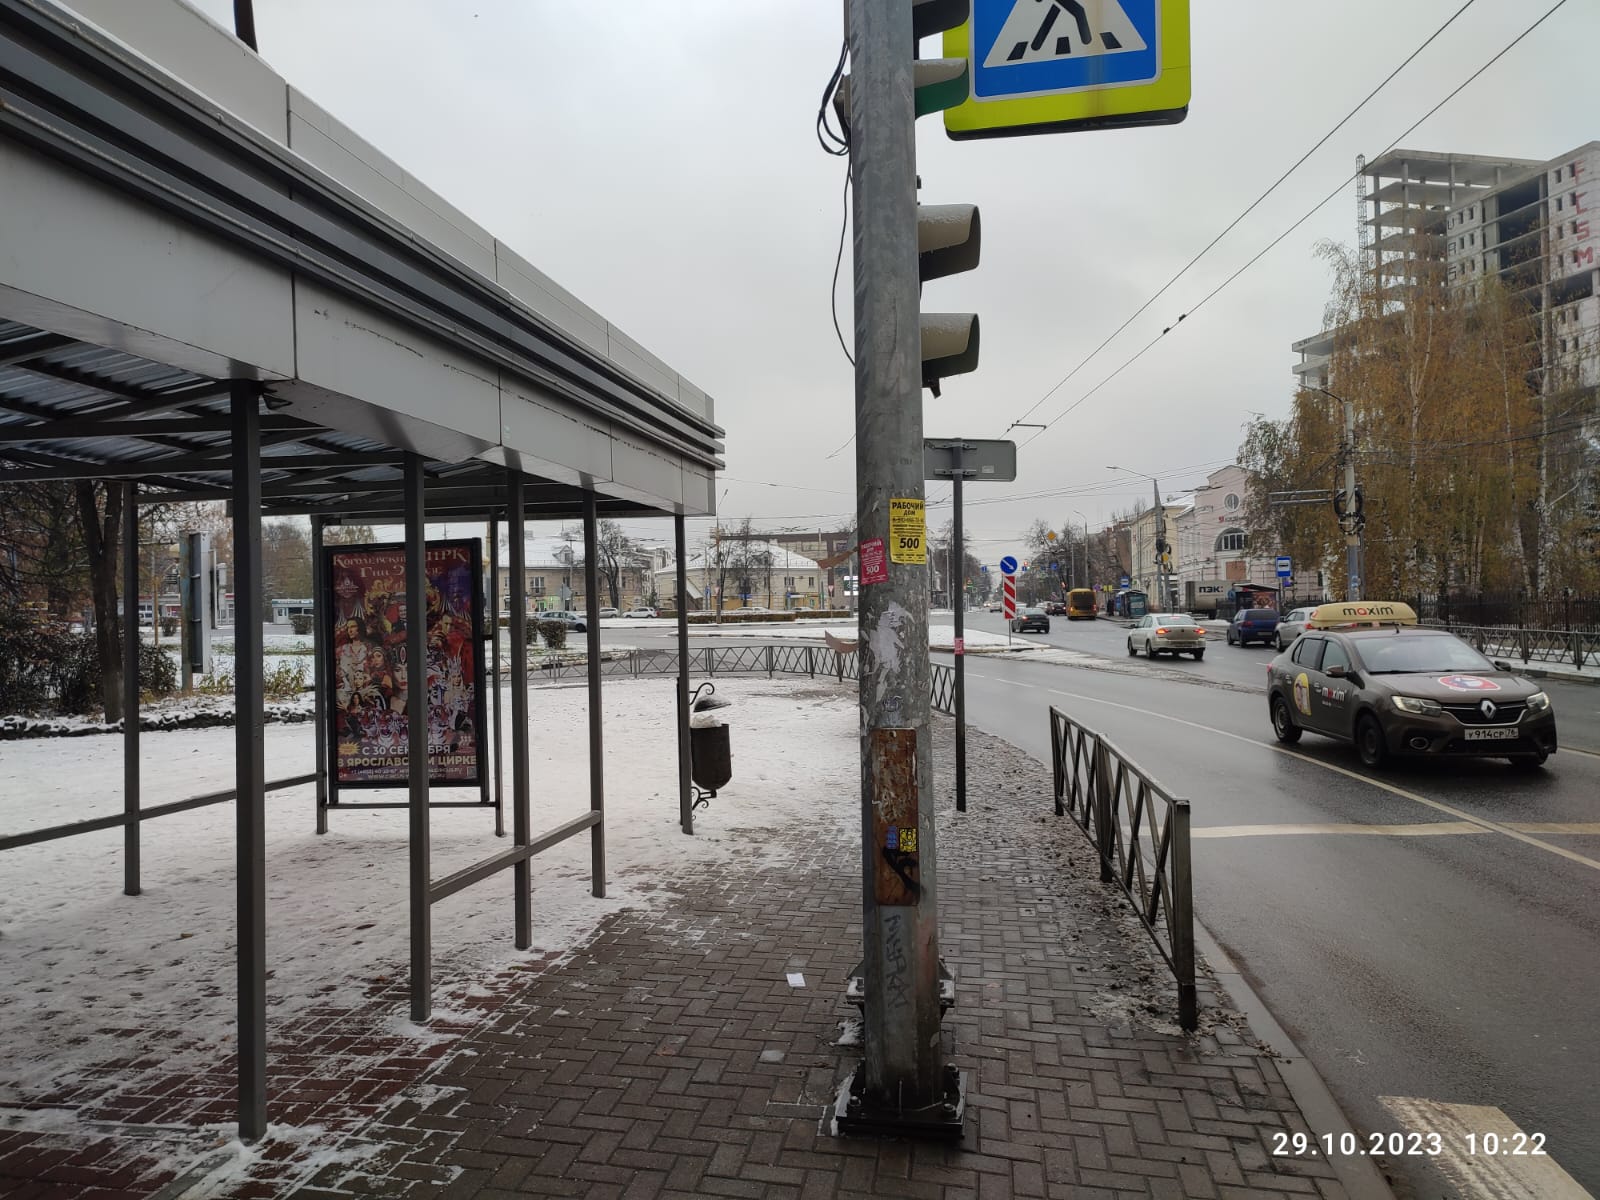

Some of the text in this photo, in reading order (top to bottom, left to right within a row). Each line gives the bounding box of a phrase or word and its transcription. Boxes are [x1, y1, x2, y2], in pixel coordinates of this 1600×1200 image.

[892, 501, 924, 510] РАБОЧИЙ
[899, 537, 920, 549] 500
[866, 565, 880, 575] 500
[1342, 606, 1394, 616] maxim
[362, 746, 370, 756] С
[373, 745, 387, 756] 30
[437, 755, 477, 767] ЦИРКЕ
